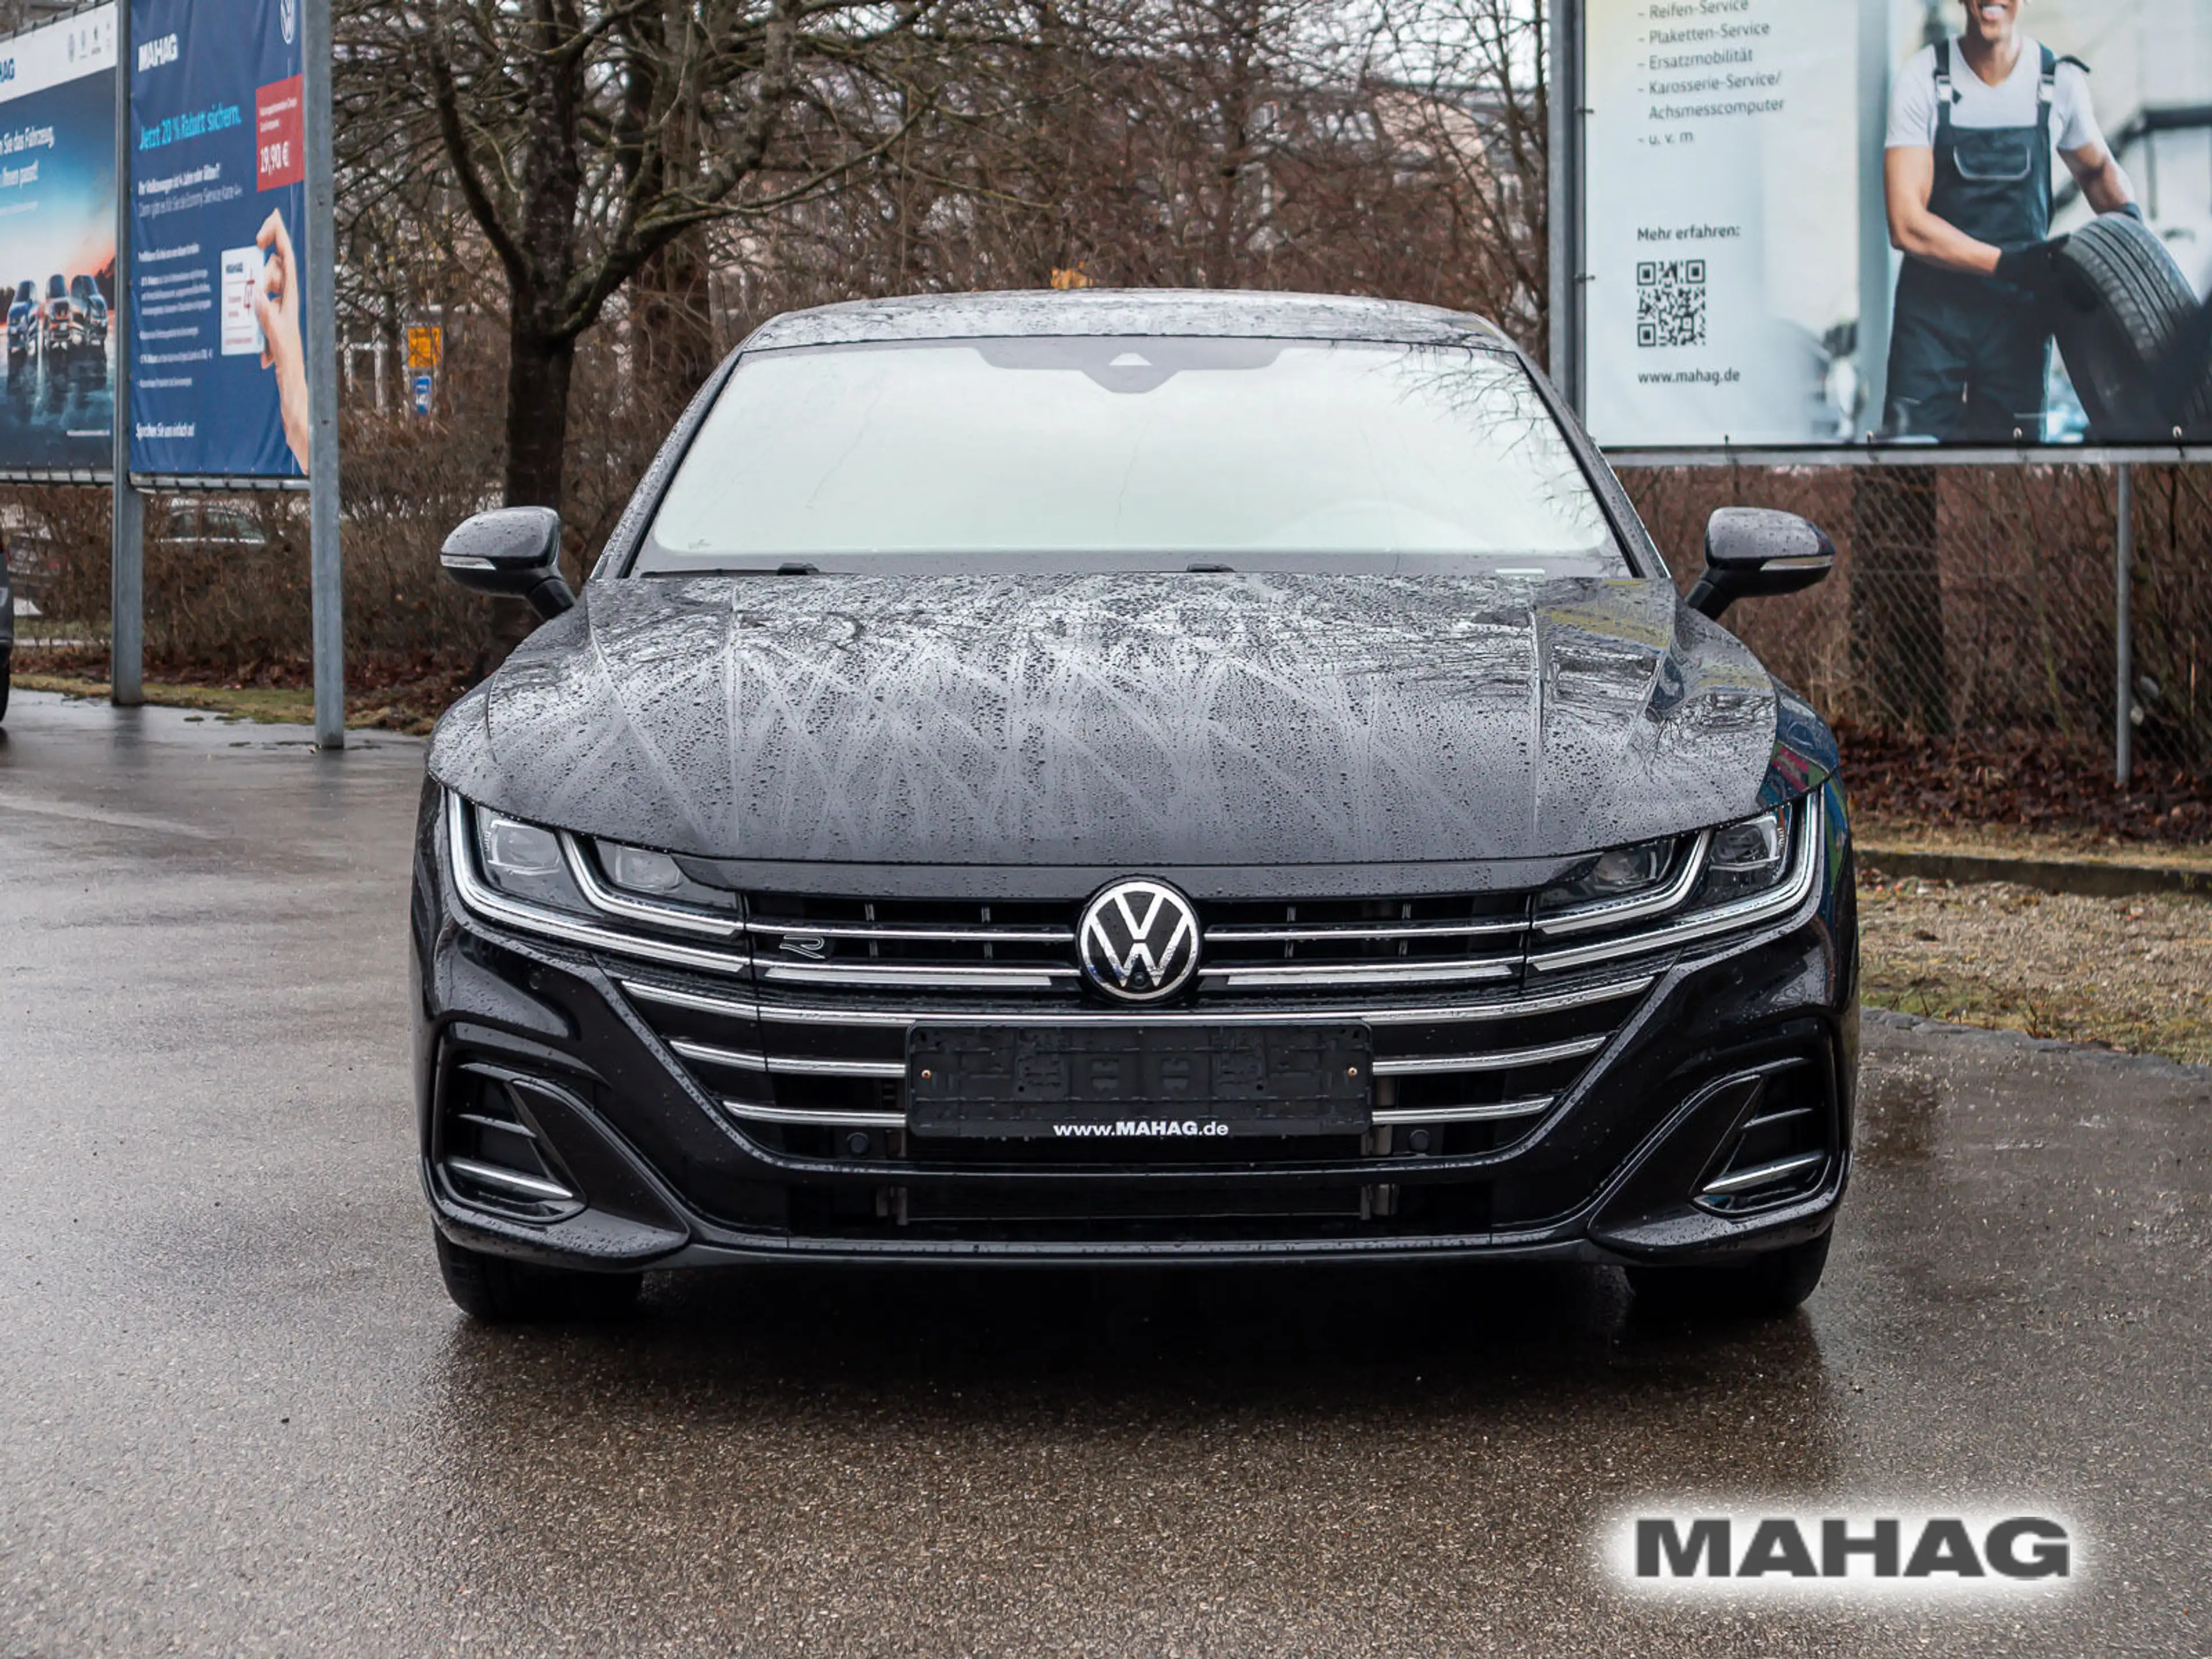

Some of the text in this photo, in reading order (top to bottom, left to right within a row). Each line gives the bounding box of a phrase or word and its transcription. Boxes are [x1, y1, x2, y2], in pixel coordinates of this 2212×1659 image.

[1649, 21, 1770, 44] Plaketten-Service
[1649, 47, 1753, 70] Ersatzmobilität
[1649, 70, 1782, 95] Karosserie-Service/
[1638, 224, 1740, 241] Mehr erfahren:
[1638, 368, 1741, 386] www.mahag.de
[1052, 1121, 1229, 1136] www.MAHAG.de
